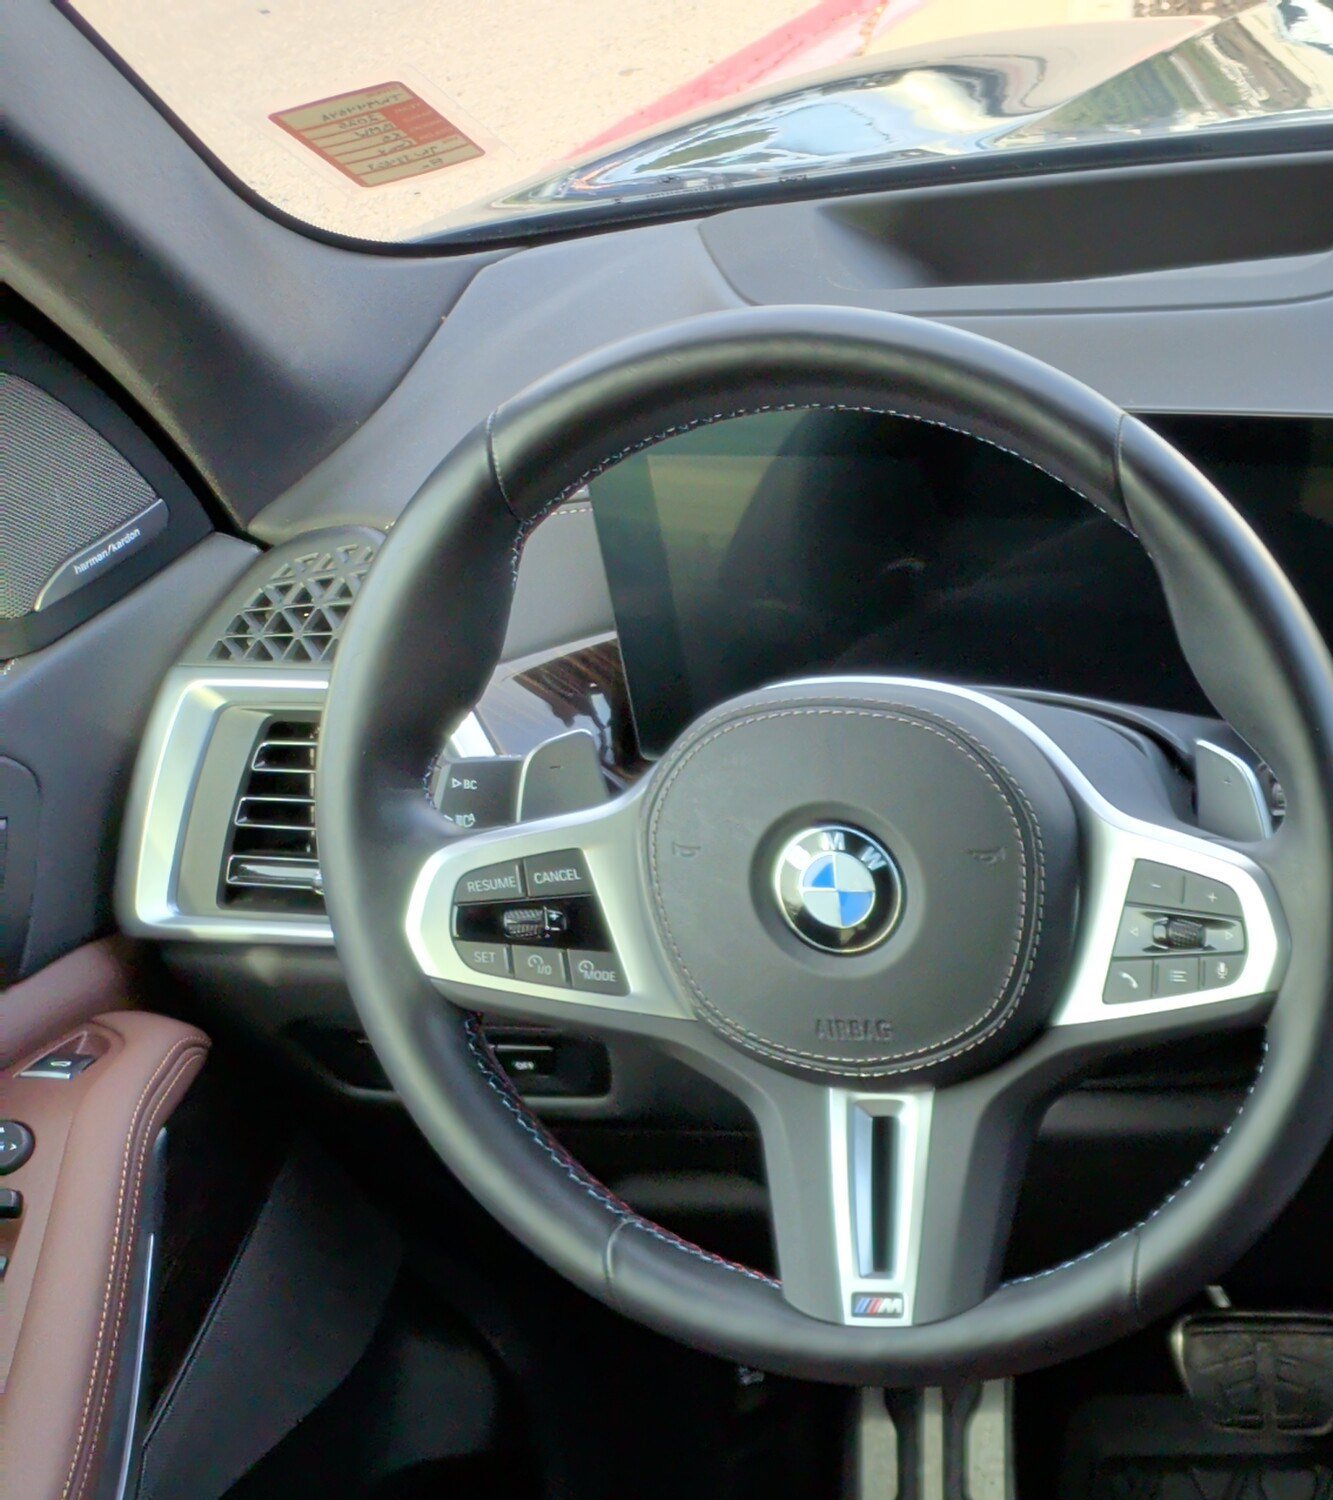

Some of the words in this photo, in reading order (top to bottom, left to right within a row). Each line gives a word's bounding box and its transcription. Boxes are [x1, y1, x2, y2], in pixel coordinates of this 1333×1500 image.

[73, 528, 141, 575] harman/kardon
[463, 778, 478, 790] BC
[534, 869, 581, 884] CANCEL
[467, 876, 516, 892] RESUME
[474, 952, 496, 963] SET
[583, 970, 616, 982] MODE
